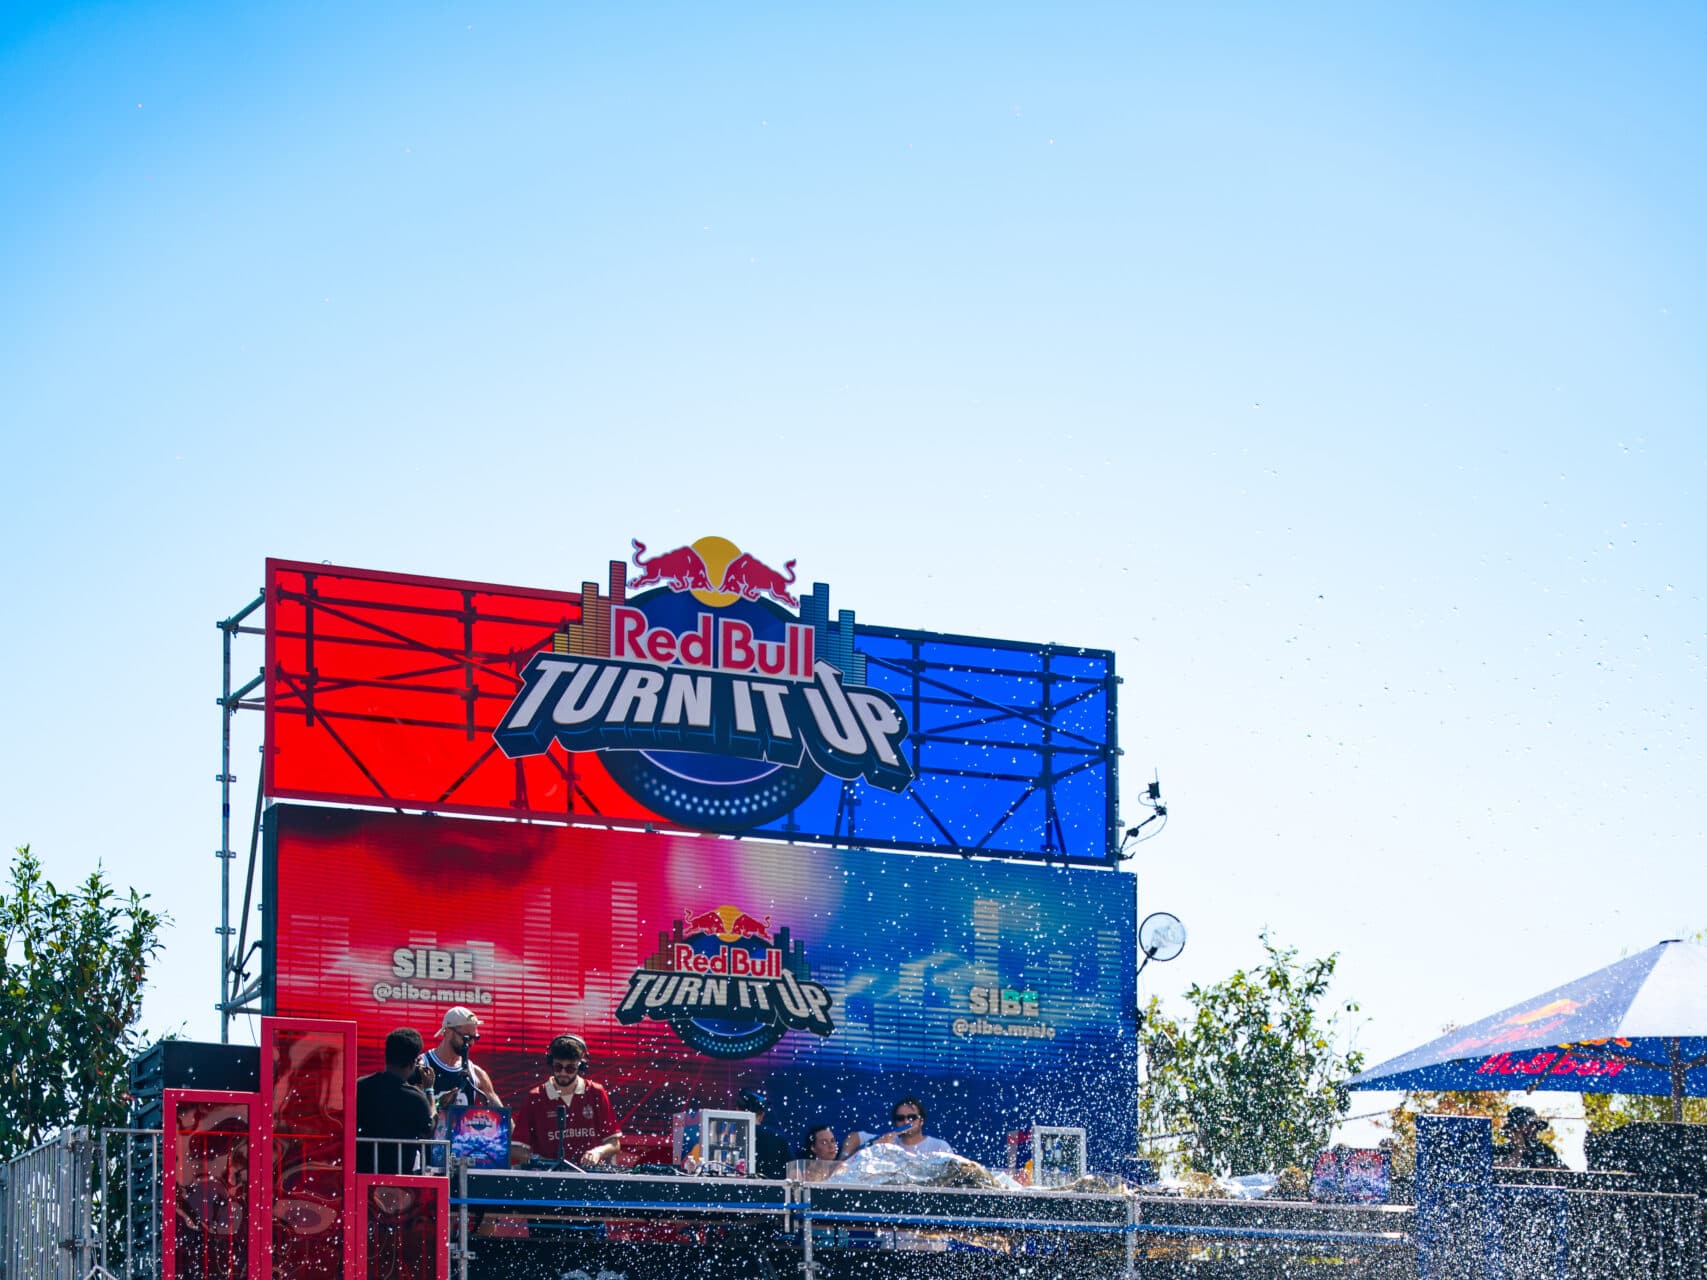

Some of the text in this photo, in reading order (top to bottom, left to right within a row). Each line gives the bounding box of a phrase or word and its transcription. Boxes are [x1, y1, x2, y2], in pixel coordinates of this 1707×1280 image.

[613, 606, 815, 678] Red Bull
[506, 659, 901, 767] TURN IT UP
[391, 947, 474, 981] SIBE
[675, 944, 782, 978] Red Bull
[620, 968, 829, 1024] TURN IT UP
[968, 986, 1040, 1017] SIBE
